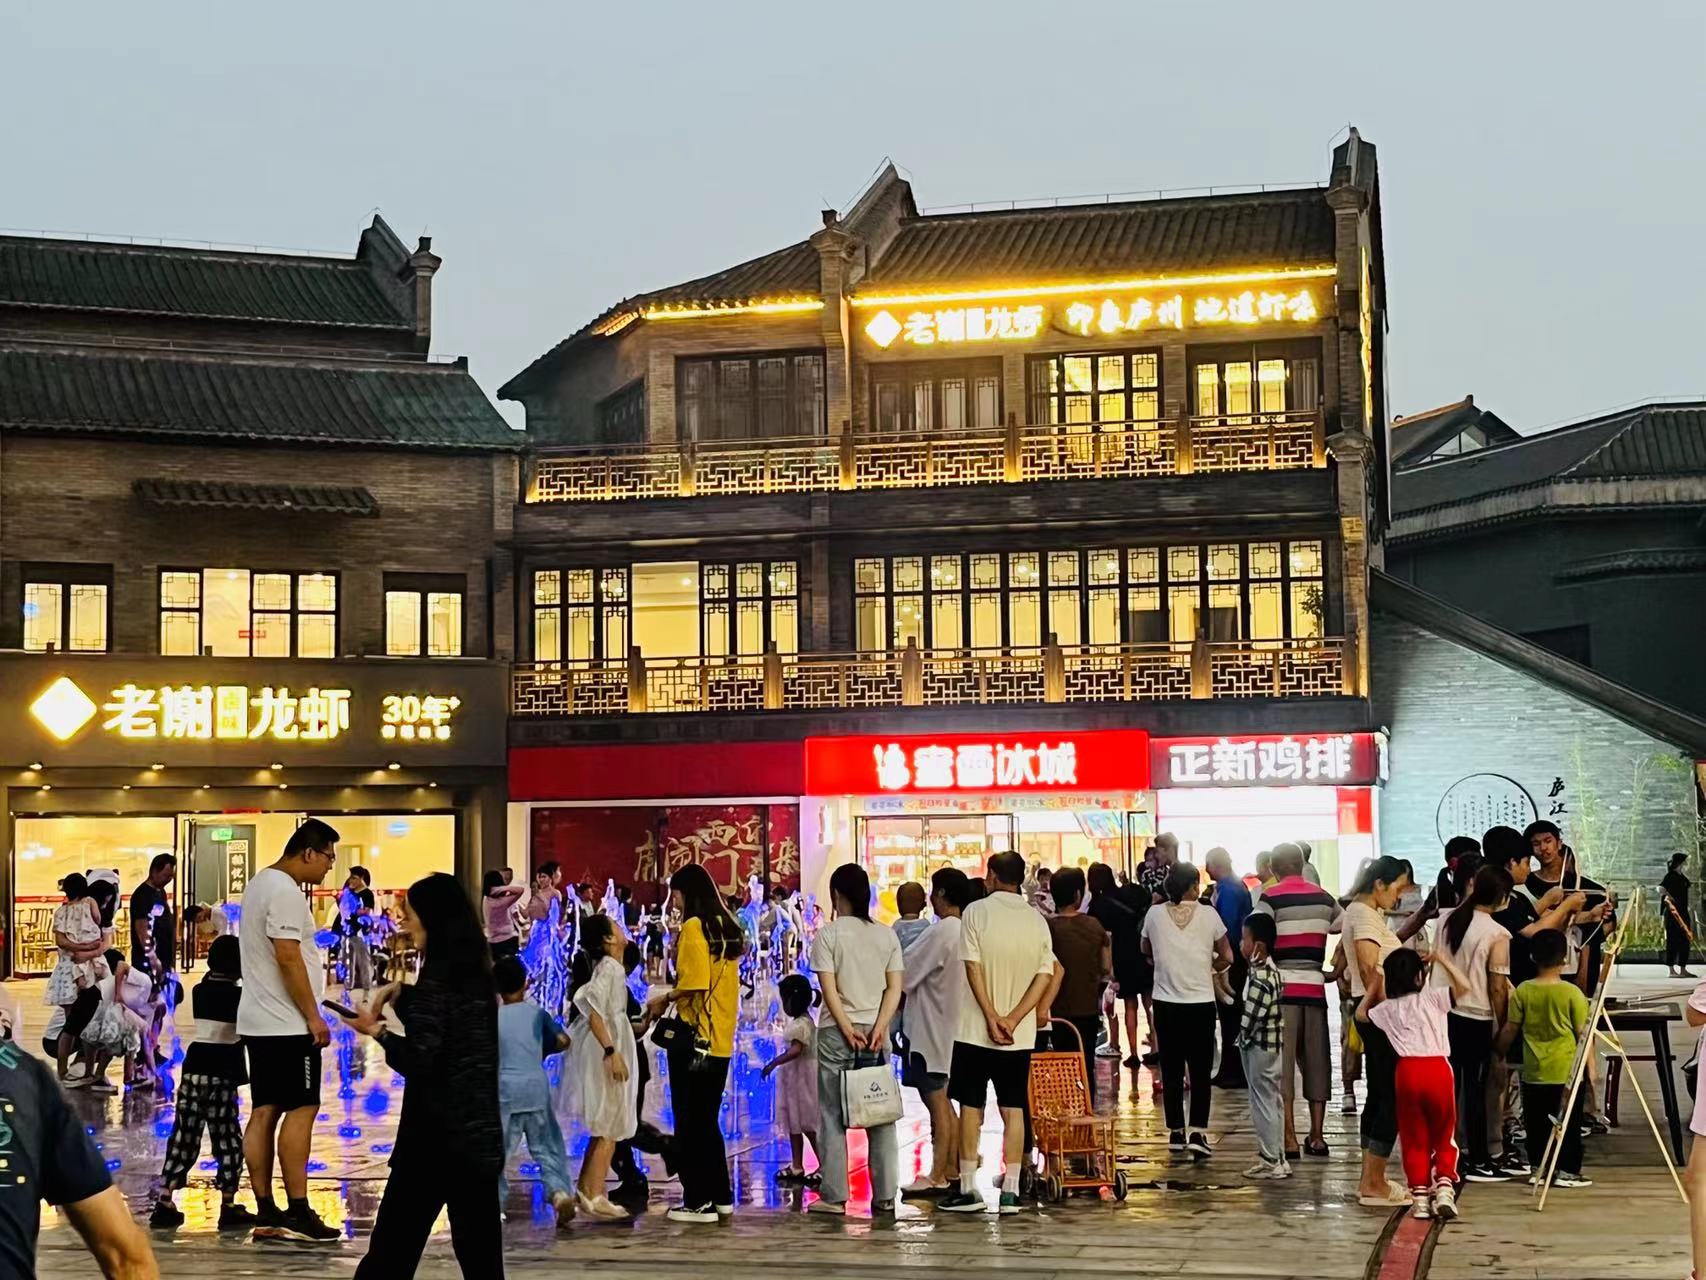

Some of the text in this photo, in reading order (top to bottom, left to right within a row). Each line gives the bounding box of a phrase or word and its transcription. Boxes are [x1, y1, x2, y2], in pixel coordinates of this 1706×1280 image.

[914, 742, 1077, 787] 蜜雪冰城
[1169, 734, 1354, 782] 正新鸡排
